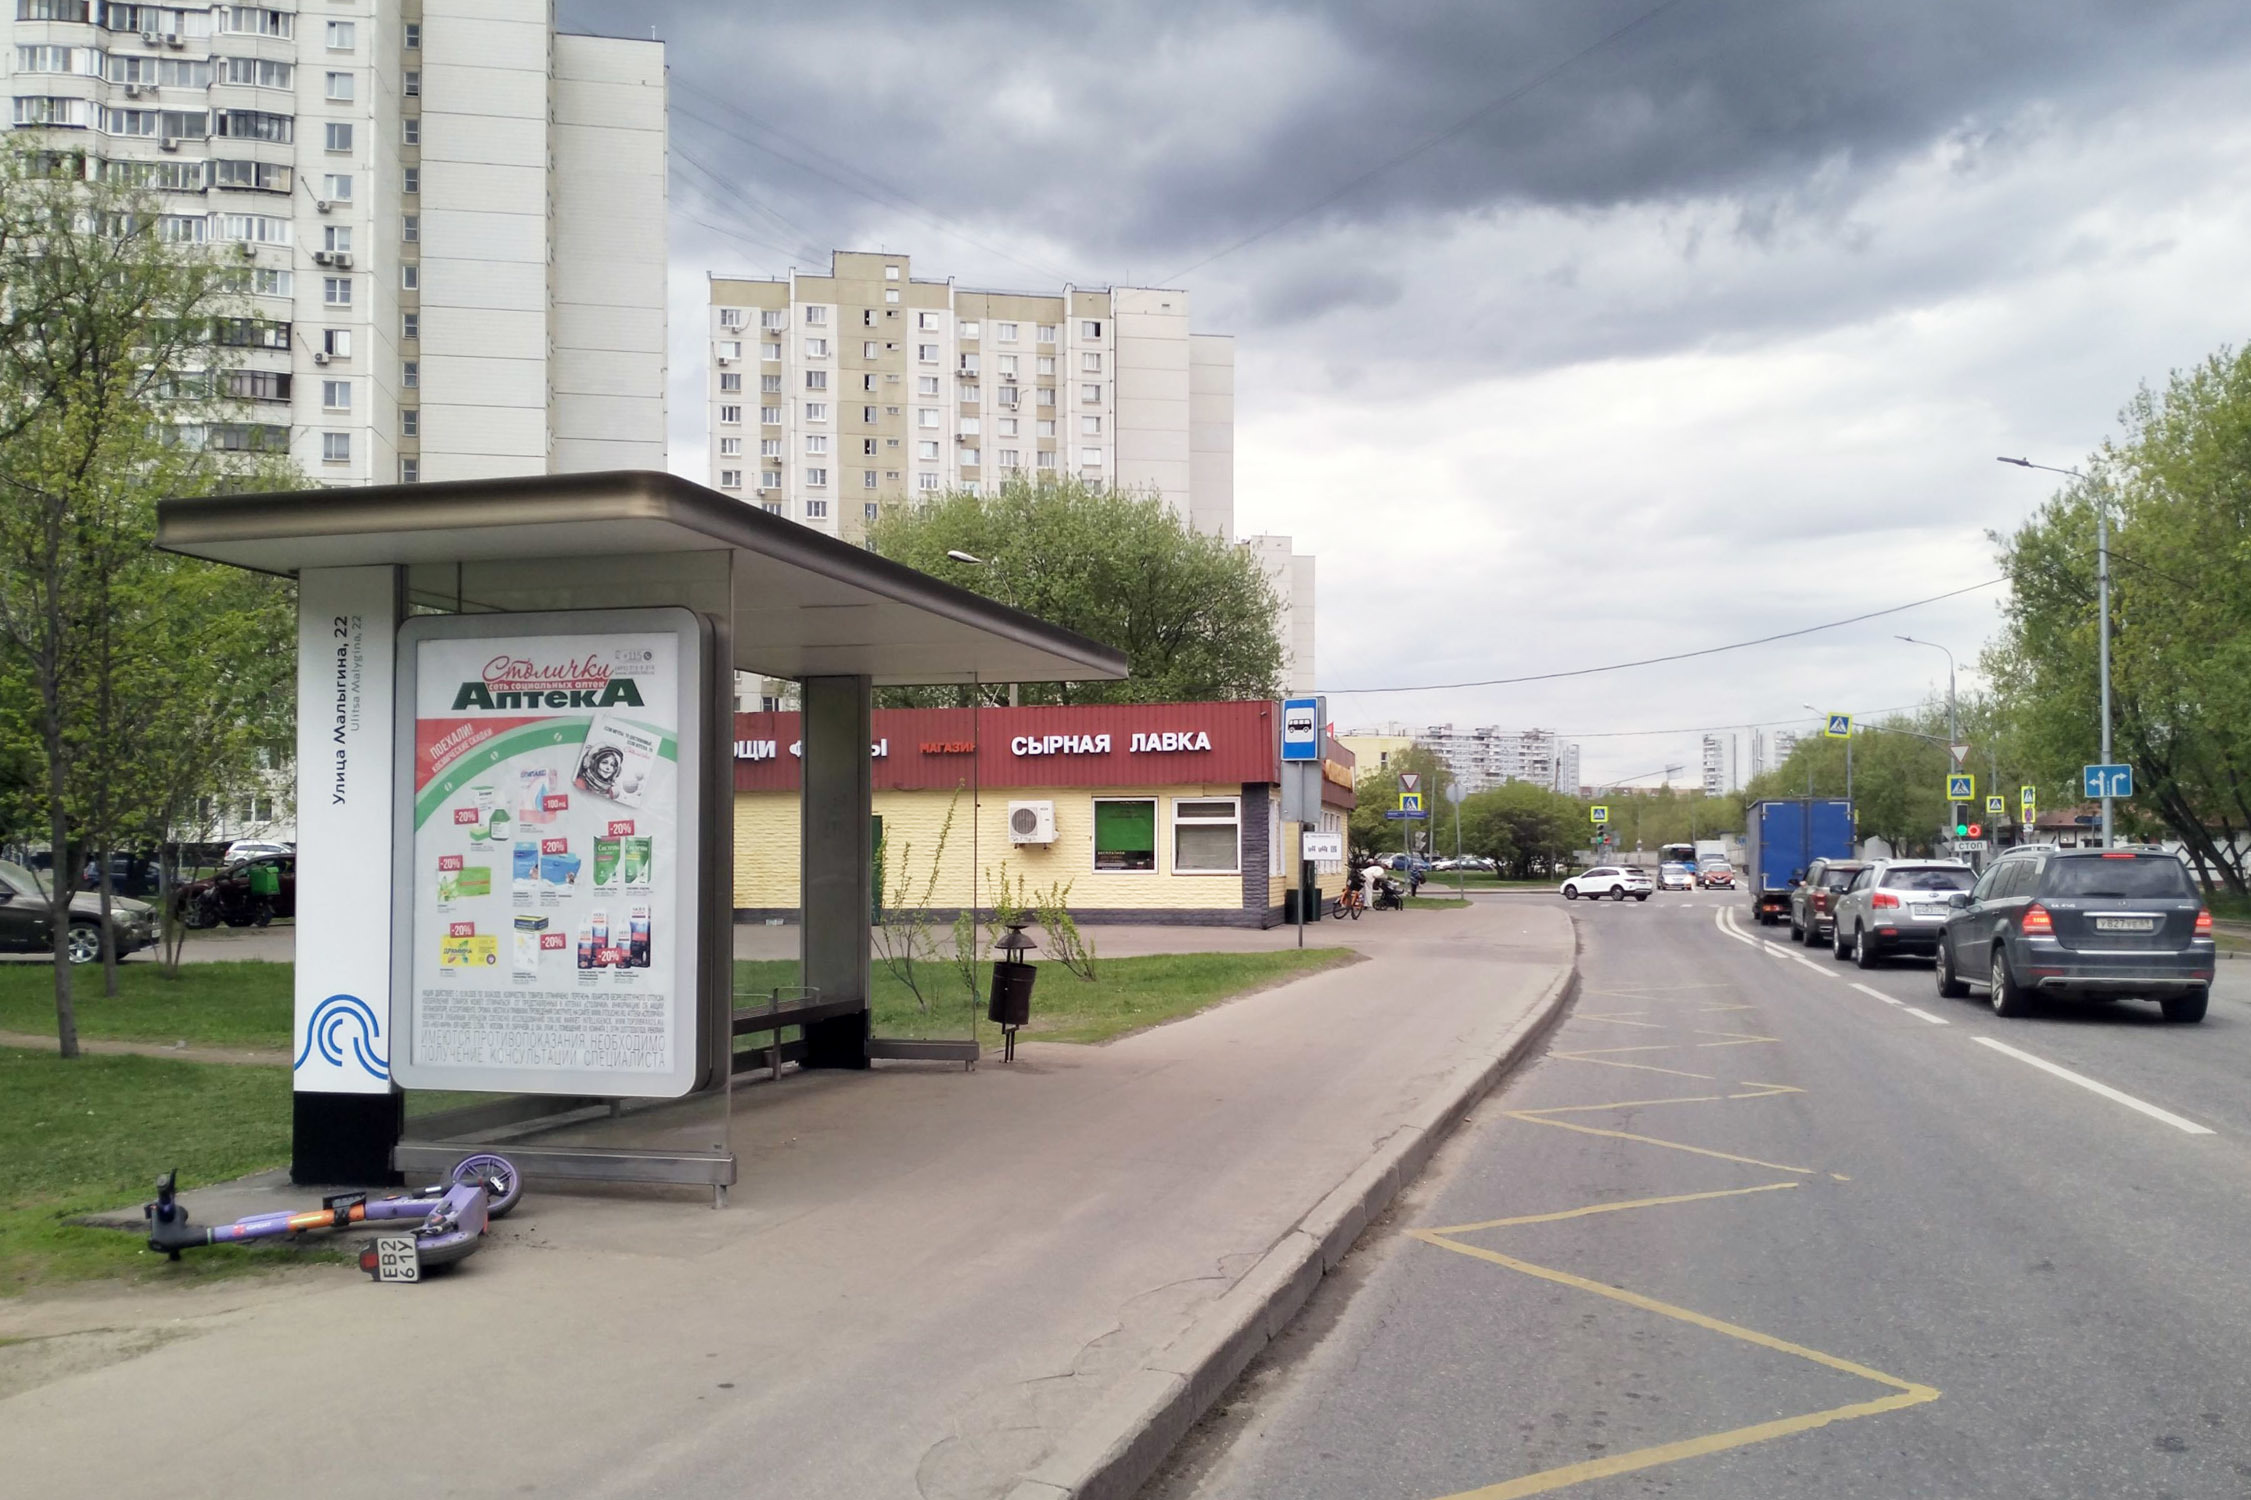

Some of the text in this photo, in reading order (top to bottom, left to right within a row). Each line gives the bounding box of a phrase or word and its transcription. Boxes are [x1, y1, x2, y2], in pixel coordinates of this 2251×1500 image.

[351, 615, 362, 630] 22
[482, 654, 615, 682] Столички
[489, 681, 605, 691] сеть социальных аптек
[333, 616, 349, 805] Улица Малыгина, 22
[350, 696, 360, 732] Ulitsa
[430, 723, 473, 760] ПОЕХАЛИ!
[734, 740, 776, 761] ЩИ
[1011, 731, 1211, 756] СЫРНАЯ ЛАВКА
[456, 812, 476, 822] -20%
[610, 823, 632, 835] -20%
[543, 842, 565, 853] -20%
[1958, 842, 1983, 850] СТОП
[440, 858, 460, 870] -20%
[451, 924, 472, 936] -20%
[542, 935, 563, 947] -20%
[598, 950, 619, 962] -20%
[421, 1029, 471, 1046] ИМЕЮТСЯ
[590, 1033, 666, 1052] НЕОБХОДИМО
[421, 1046, 666, 1068] ПОЛУЧЕНИЕ КОНСУЛЬТАЦИИ СПЕЦИАЛИСТА
[381, 1240, 398, 1278] ЕВ2
[397, 1240, 415, 1279] 61У
